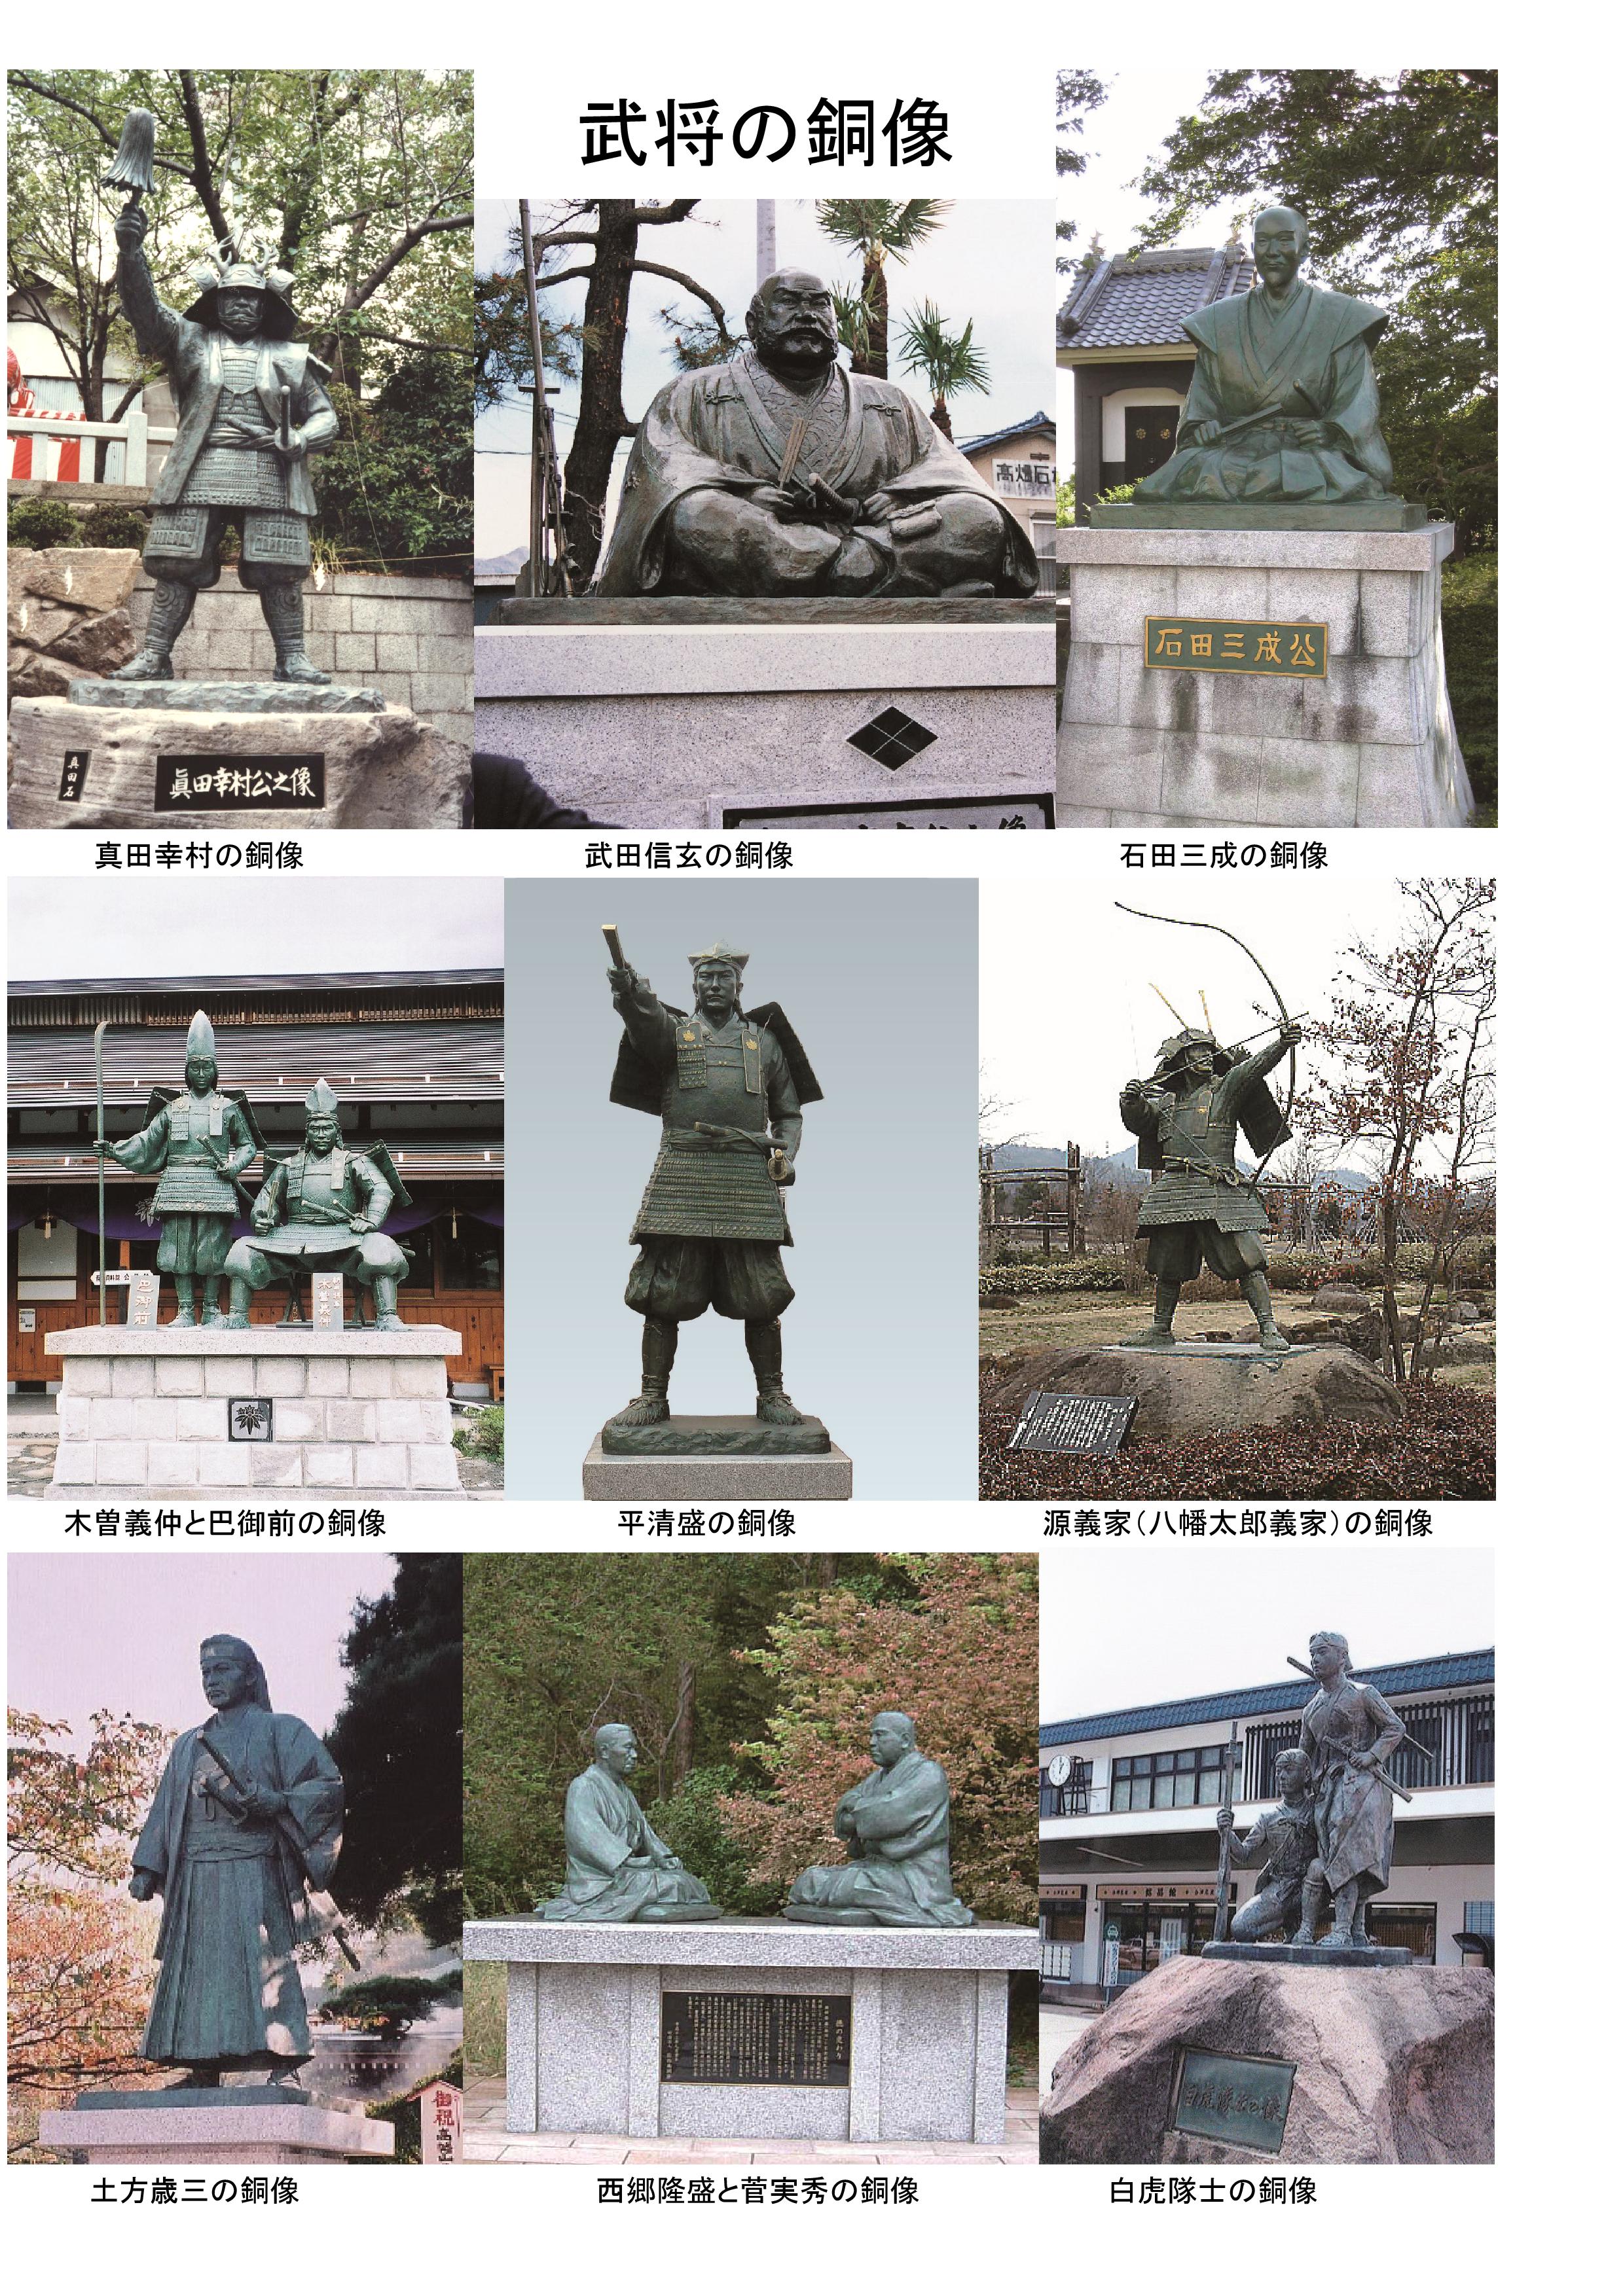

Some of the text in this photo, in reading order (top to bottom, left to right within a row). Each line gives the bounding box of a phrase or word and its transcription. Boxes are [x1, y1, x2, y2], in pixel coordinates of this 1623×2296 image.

[1155, 628, 1316, 667] 石田三成公
[63, 756, 79, 797] 真田石
